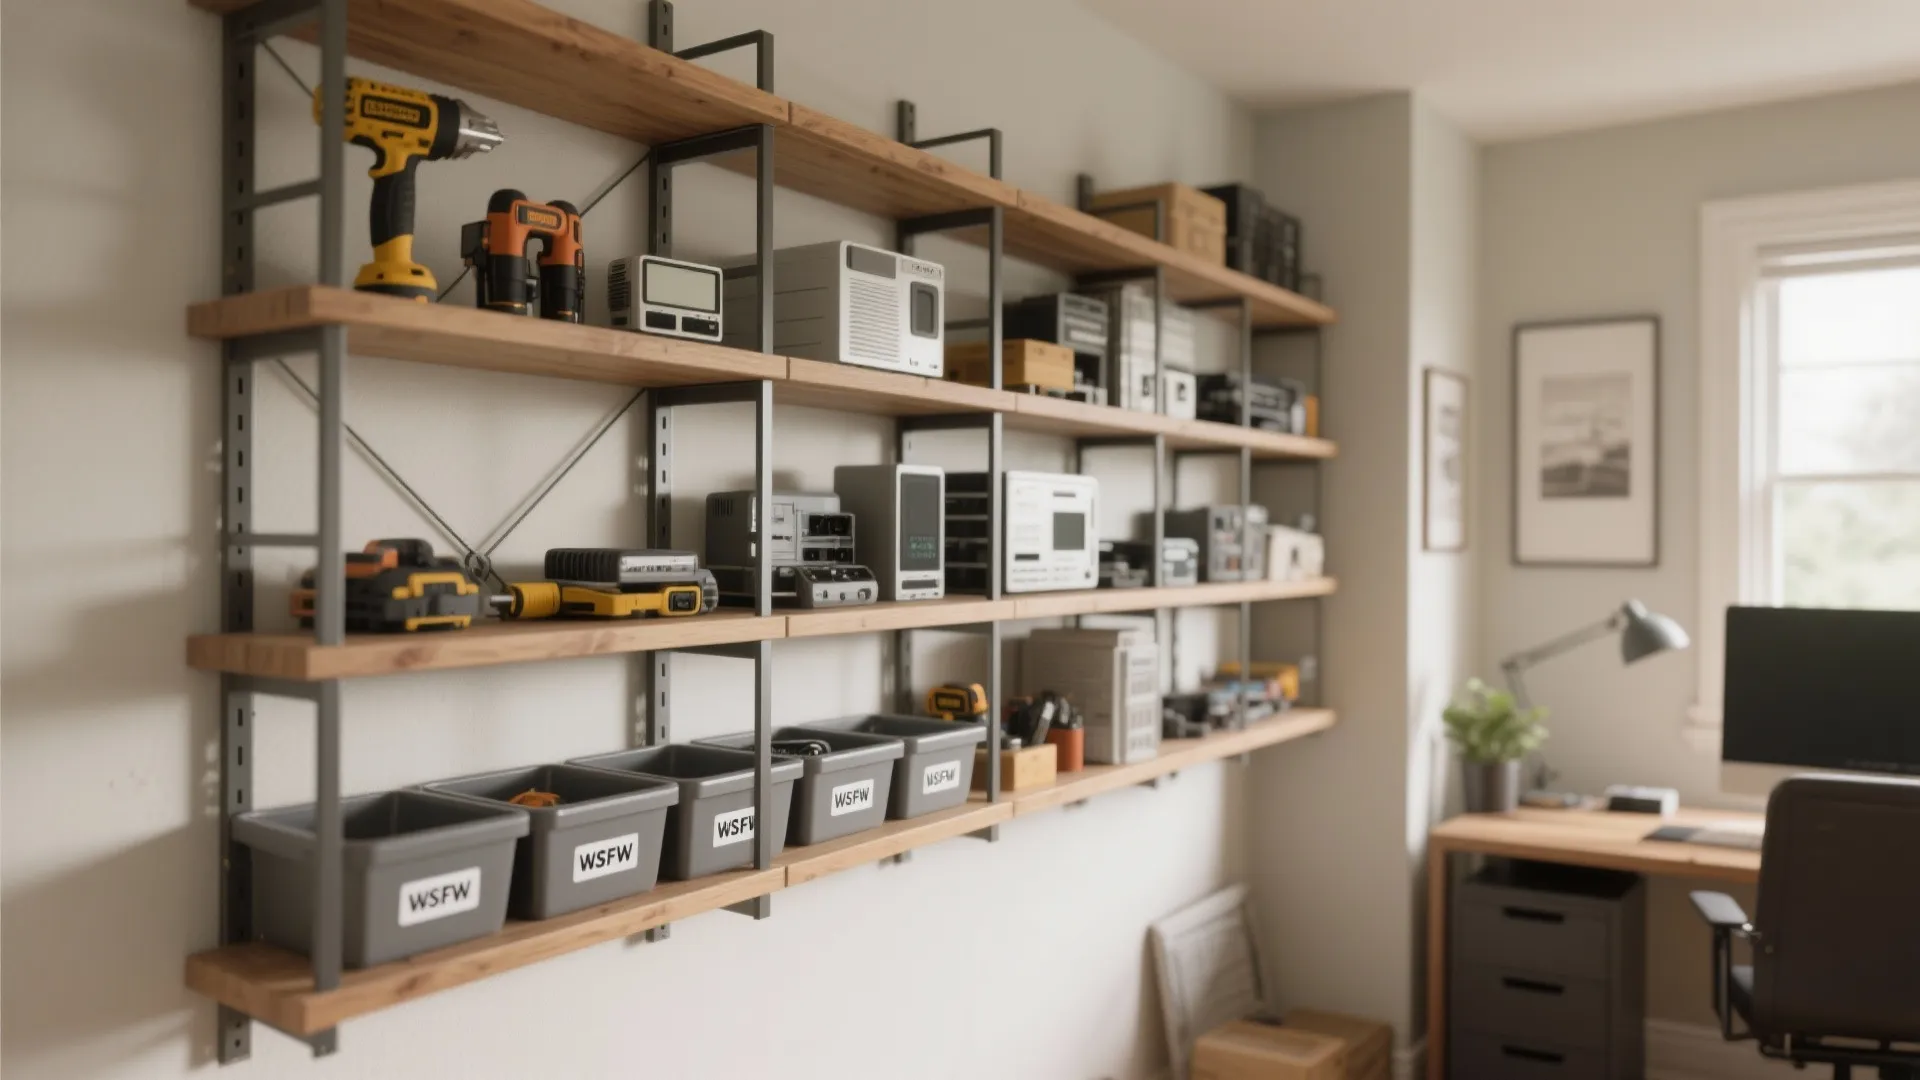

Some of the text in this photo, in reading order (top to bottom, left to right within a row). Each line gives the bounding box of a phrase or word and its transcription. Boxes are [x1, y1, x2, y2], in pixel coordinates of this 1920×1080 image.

[835, 786, 870, 808] WSFW
[580, 842, 633, 872] WSFW
[409, 879, 471, 912] WSFW
